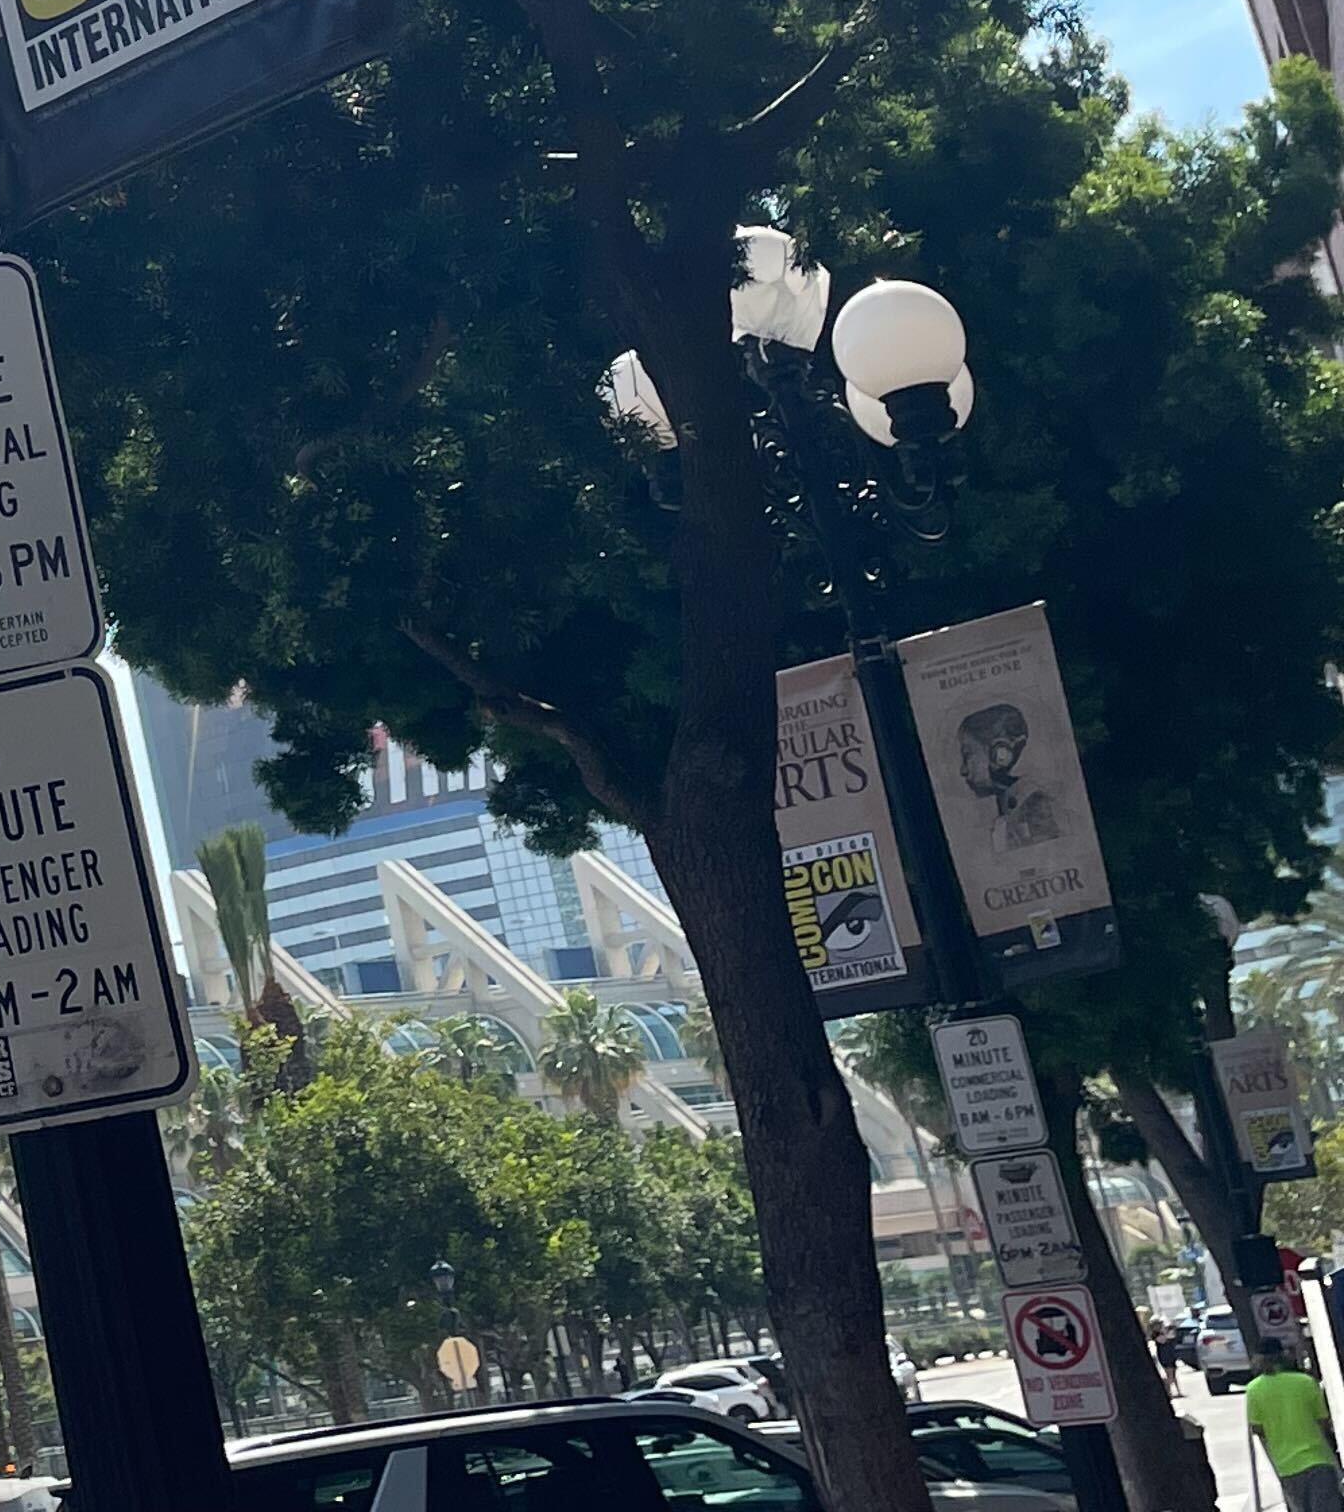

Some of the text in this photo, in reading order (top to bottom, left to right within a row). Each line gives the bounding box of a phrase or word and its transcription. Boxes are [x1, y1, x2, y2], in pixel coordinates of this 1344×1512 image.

[774, 747, 869, 811] RTS
[811, 850, 876, 894] CON
[983, 867, 1085, 911] CREATOR
[952, 1046, 1014, 1068] MINUTE
[966, 1028, 989, 1047] 20
